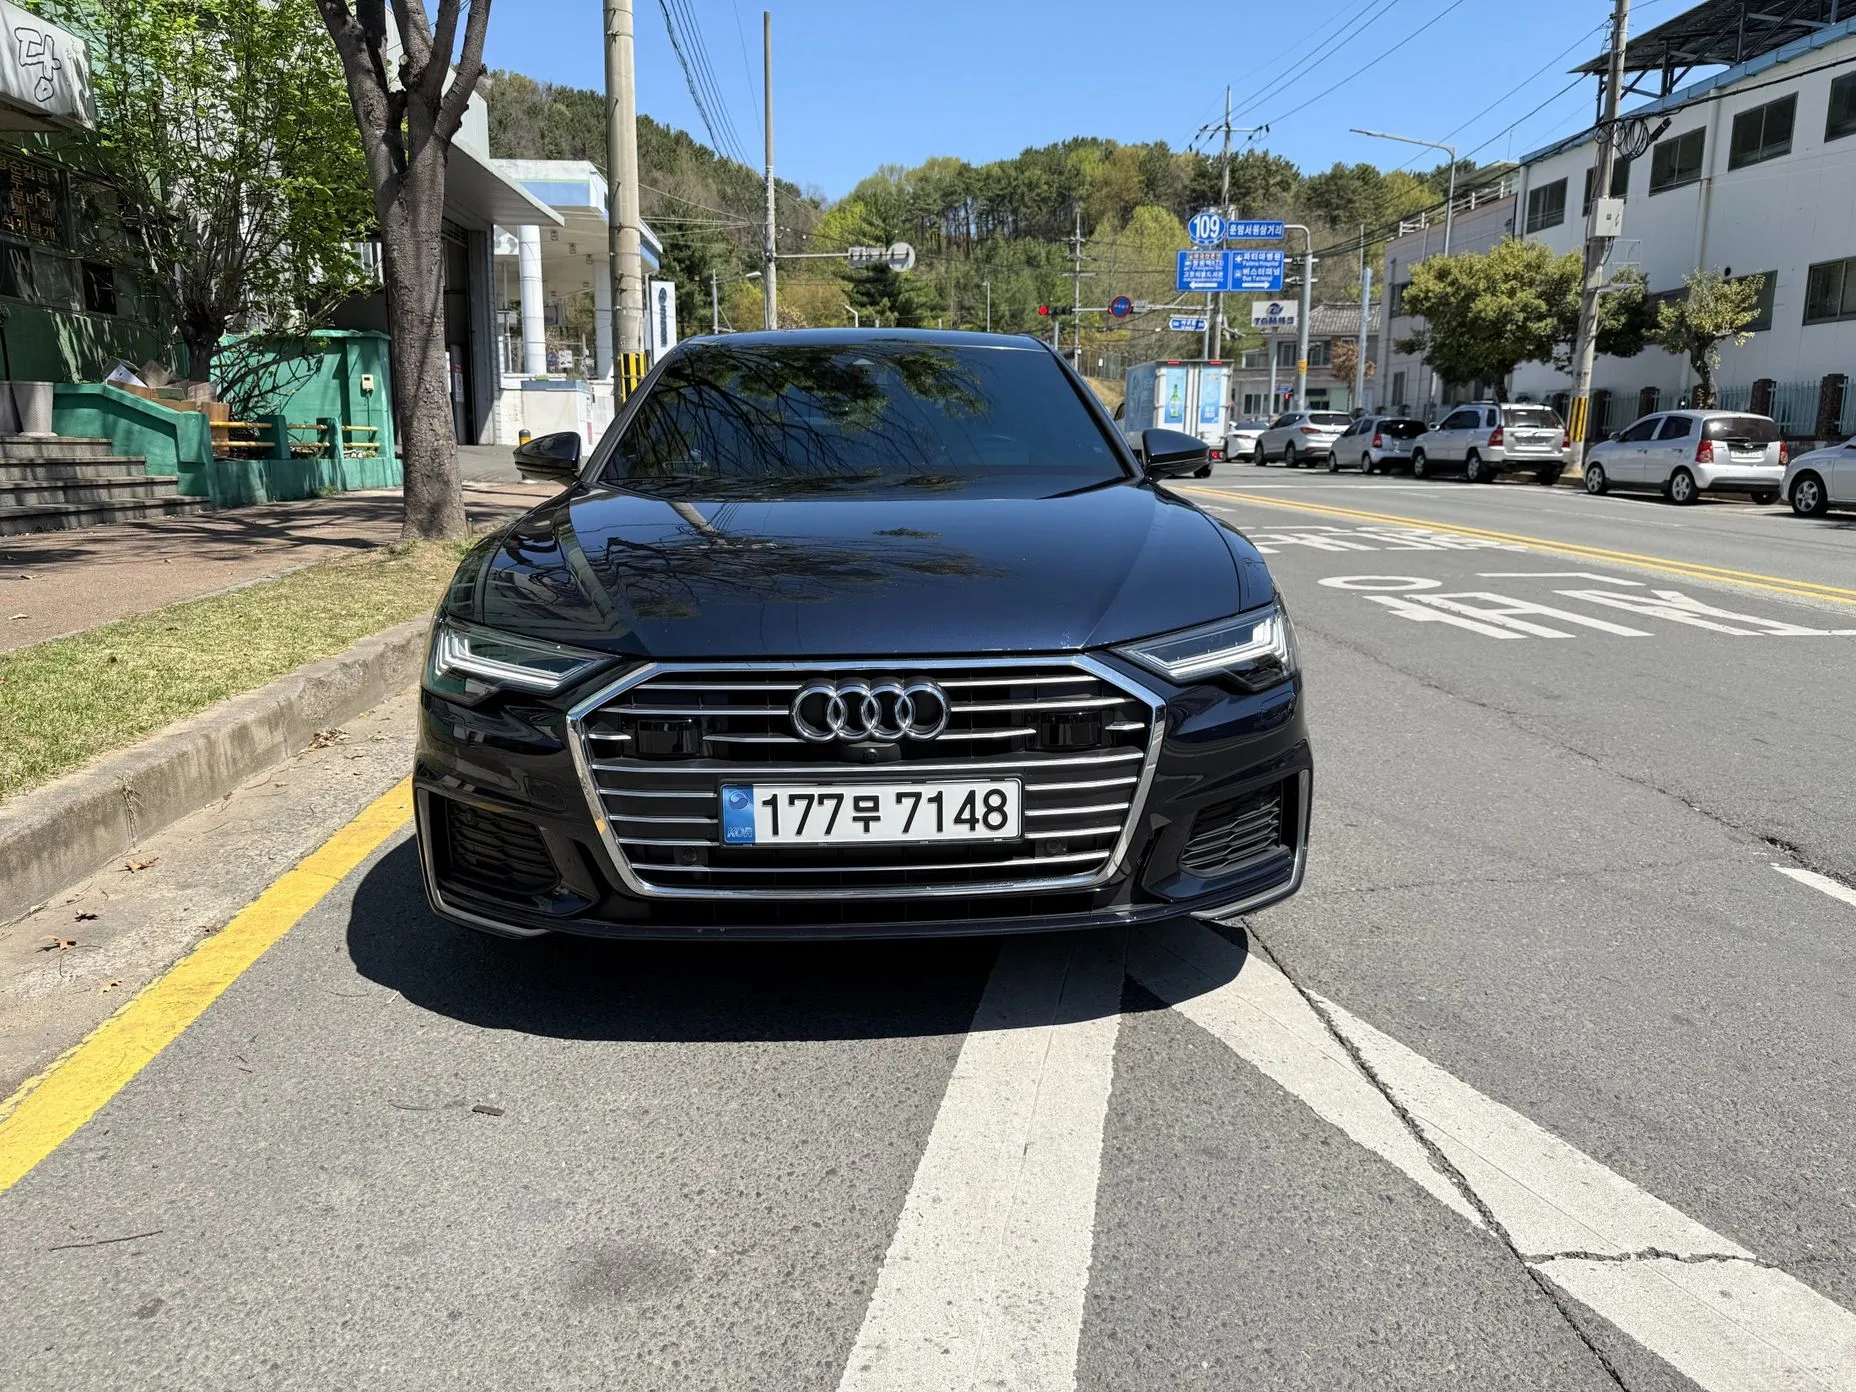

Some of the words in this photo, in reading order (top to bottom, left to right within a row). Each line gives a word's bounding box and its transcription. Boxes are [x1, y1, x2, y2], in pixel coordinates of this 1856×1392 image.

[14, 27, 62, 102] 당
[1194, 216, 1220, 238] 109
[1229, 224, 1282, 236] 운암서원삼거리
[1243, 252, 1281, 261] 파티마병원
[1242, 267, 1280, 276] 버스터미널
[1318, 572, 1856, 639] 전방
[762, 792, 881, 836] 177무
[896, 788, 1009, 833] 7148
[727, 826, 753, 838] KOR
